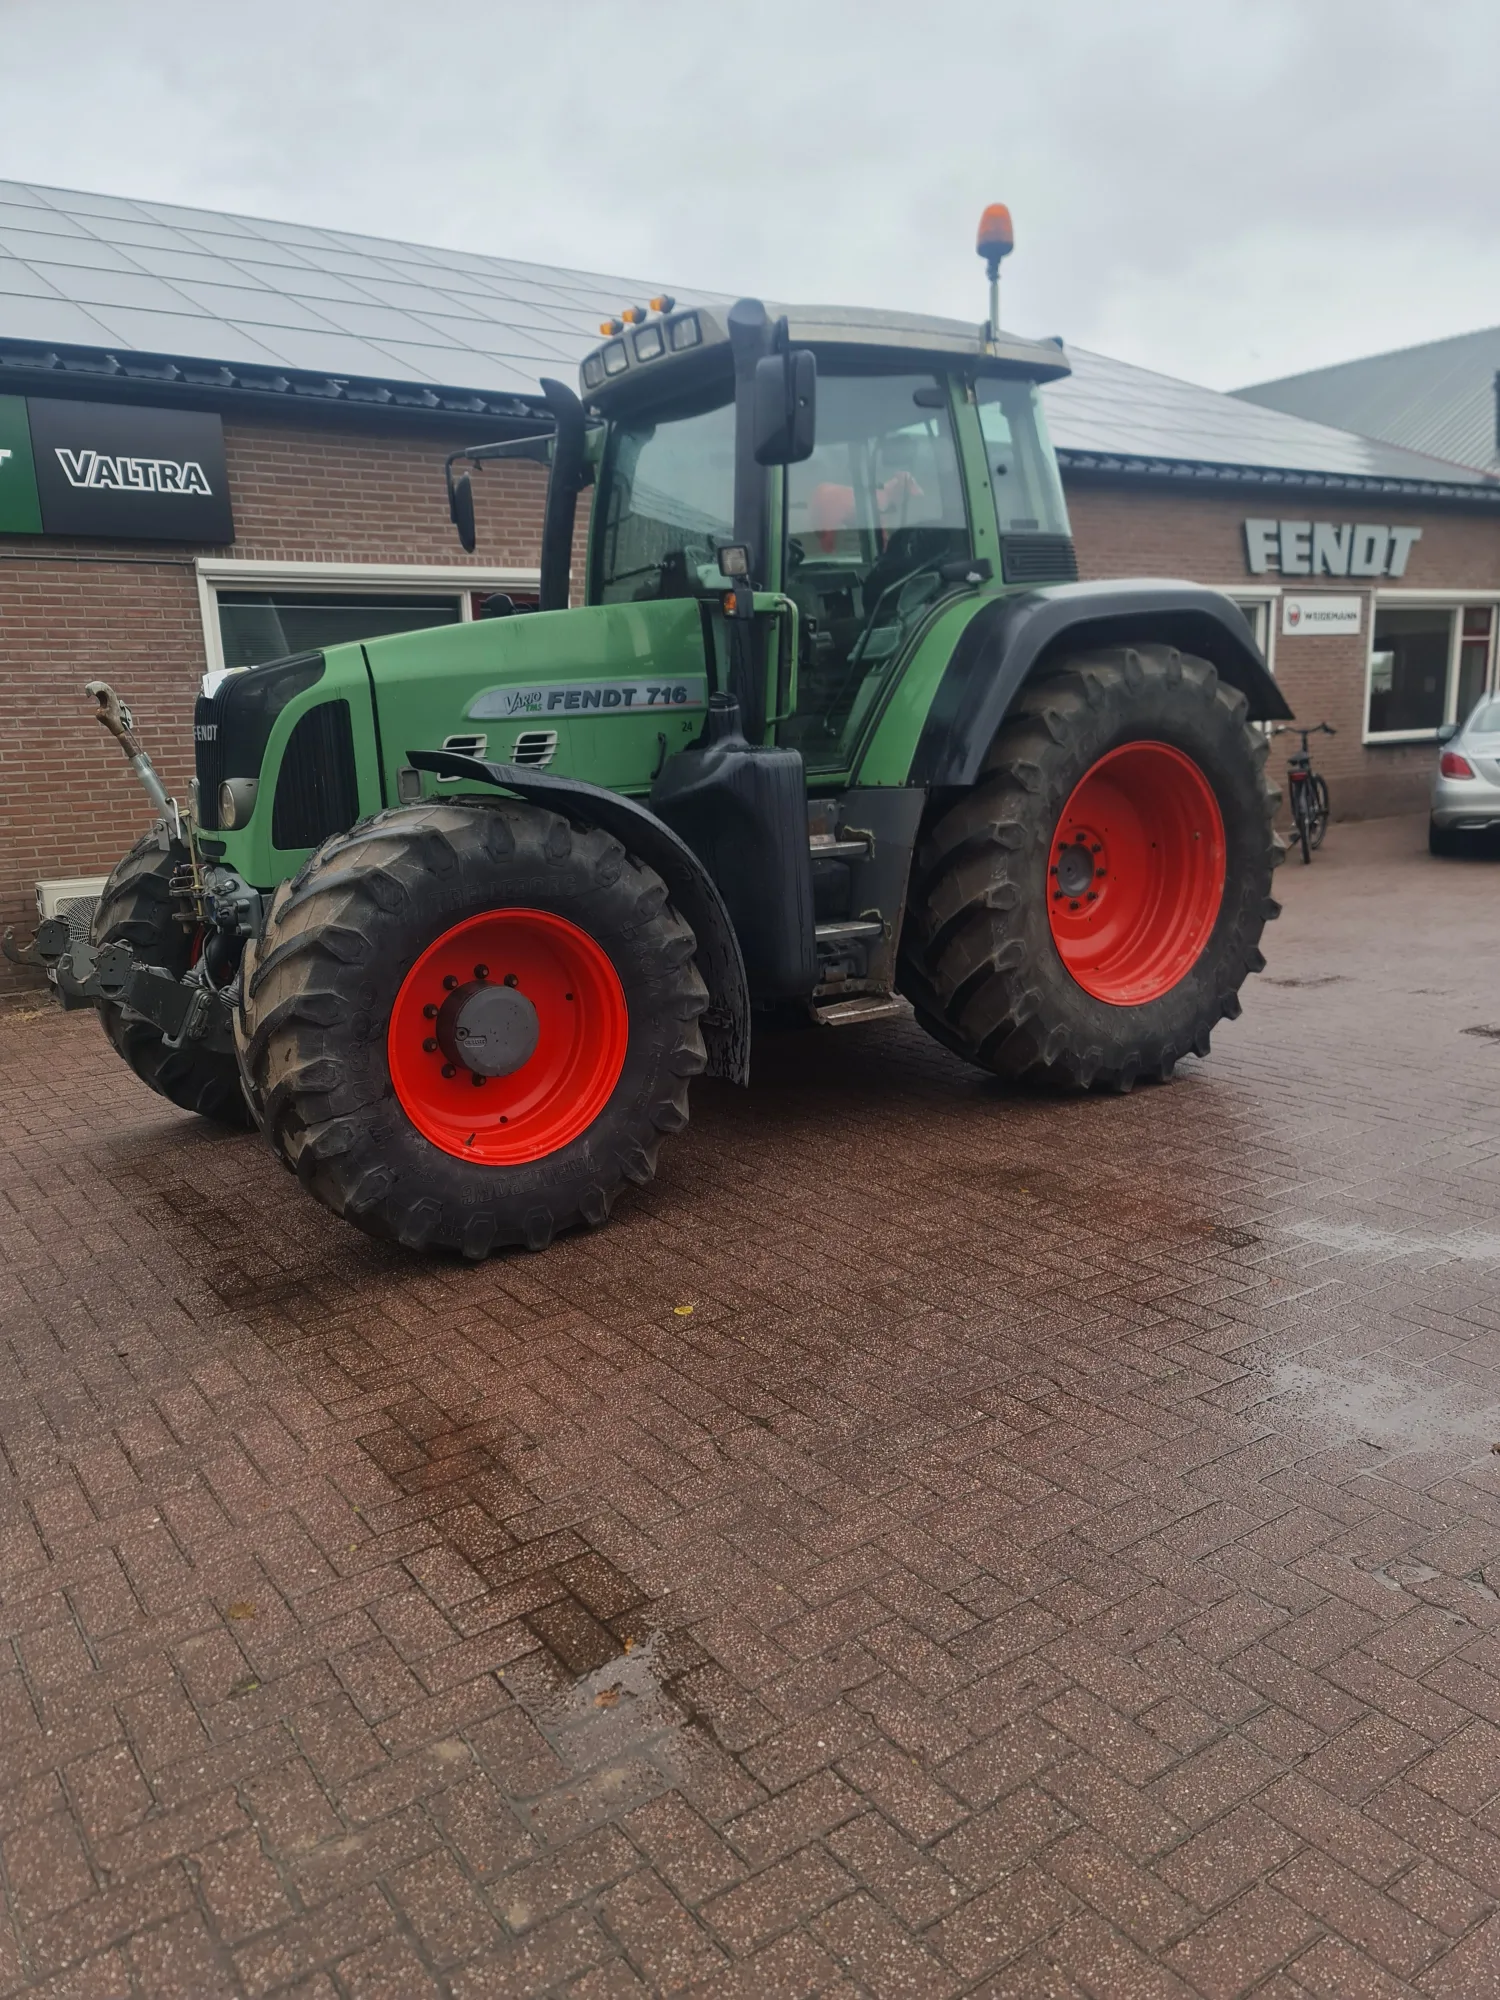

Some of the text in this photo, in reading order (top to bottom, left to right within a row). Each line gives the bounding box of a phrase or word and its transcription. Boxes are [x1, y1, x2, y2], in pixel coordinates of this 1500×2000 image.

[55, 448, 212, 495] VALTRA
[1245, 518, 1423, 577] FENDT
[1304, 611, 1357, 621] WEIDEMANN
[525, 703, 543, 712] TMS
[547, 688, 637, 711] FENDT
[646, 686, 688, 705] 716
[681, 721, 693, 732] 24
[428, 873, 578, 913] TRELLEBORG
[460, 1154, 602, 1207] TRELLEBORG
